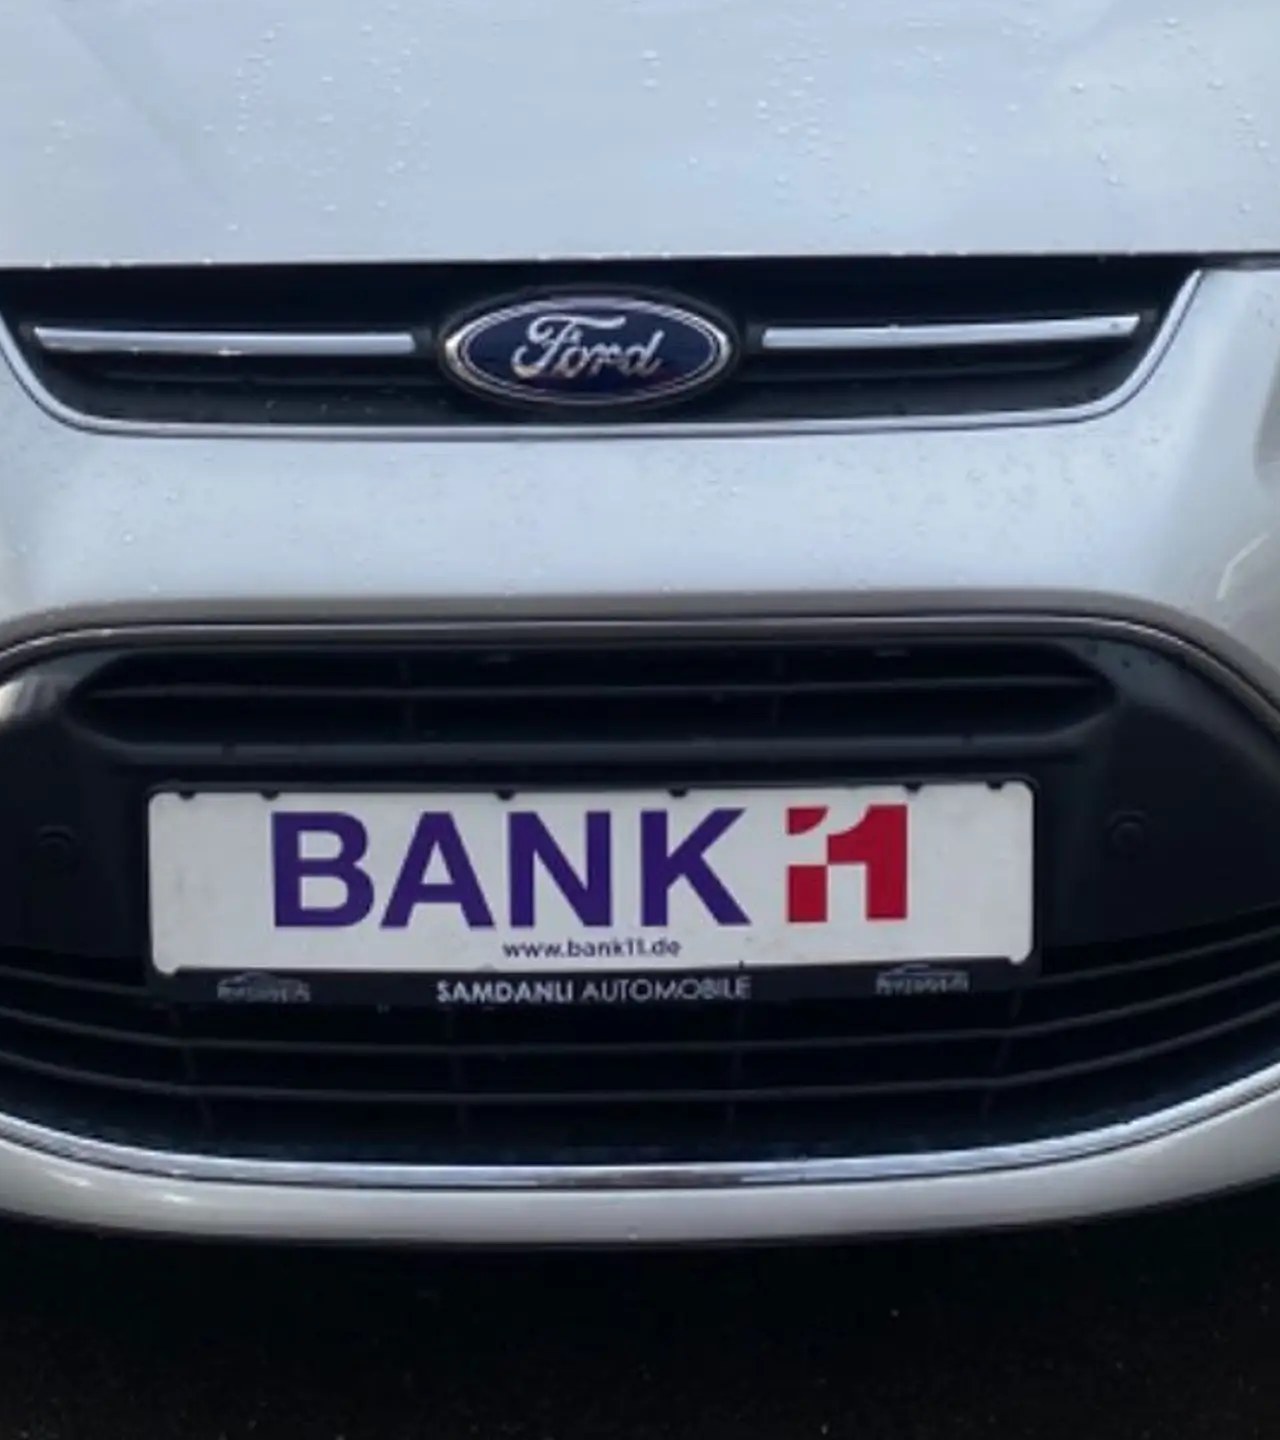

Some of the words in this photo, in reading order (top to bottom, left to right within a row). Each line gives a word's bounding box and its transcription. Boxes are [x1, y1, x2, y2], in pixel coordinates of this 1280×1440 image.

[511, 315, 664, 379] Ford
[271, 808, 752, 930] BANK
[502, 937, 682, 959] www.bank11.de
[436, 979, 572, 1003] SAMDANLI
[581, 975, 753, 1002] AUTOMOBILE
